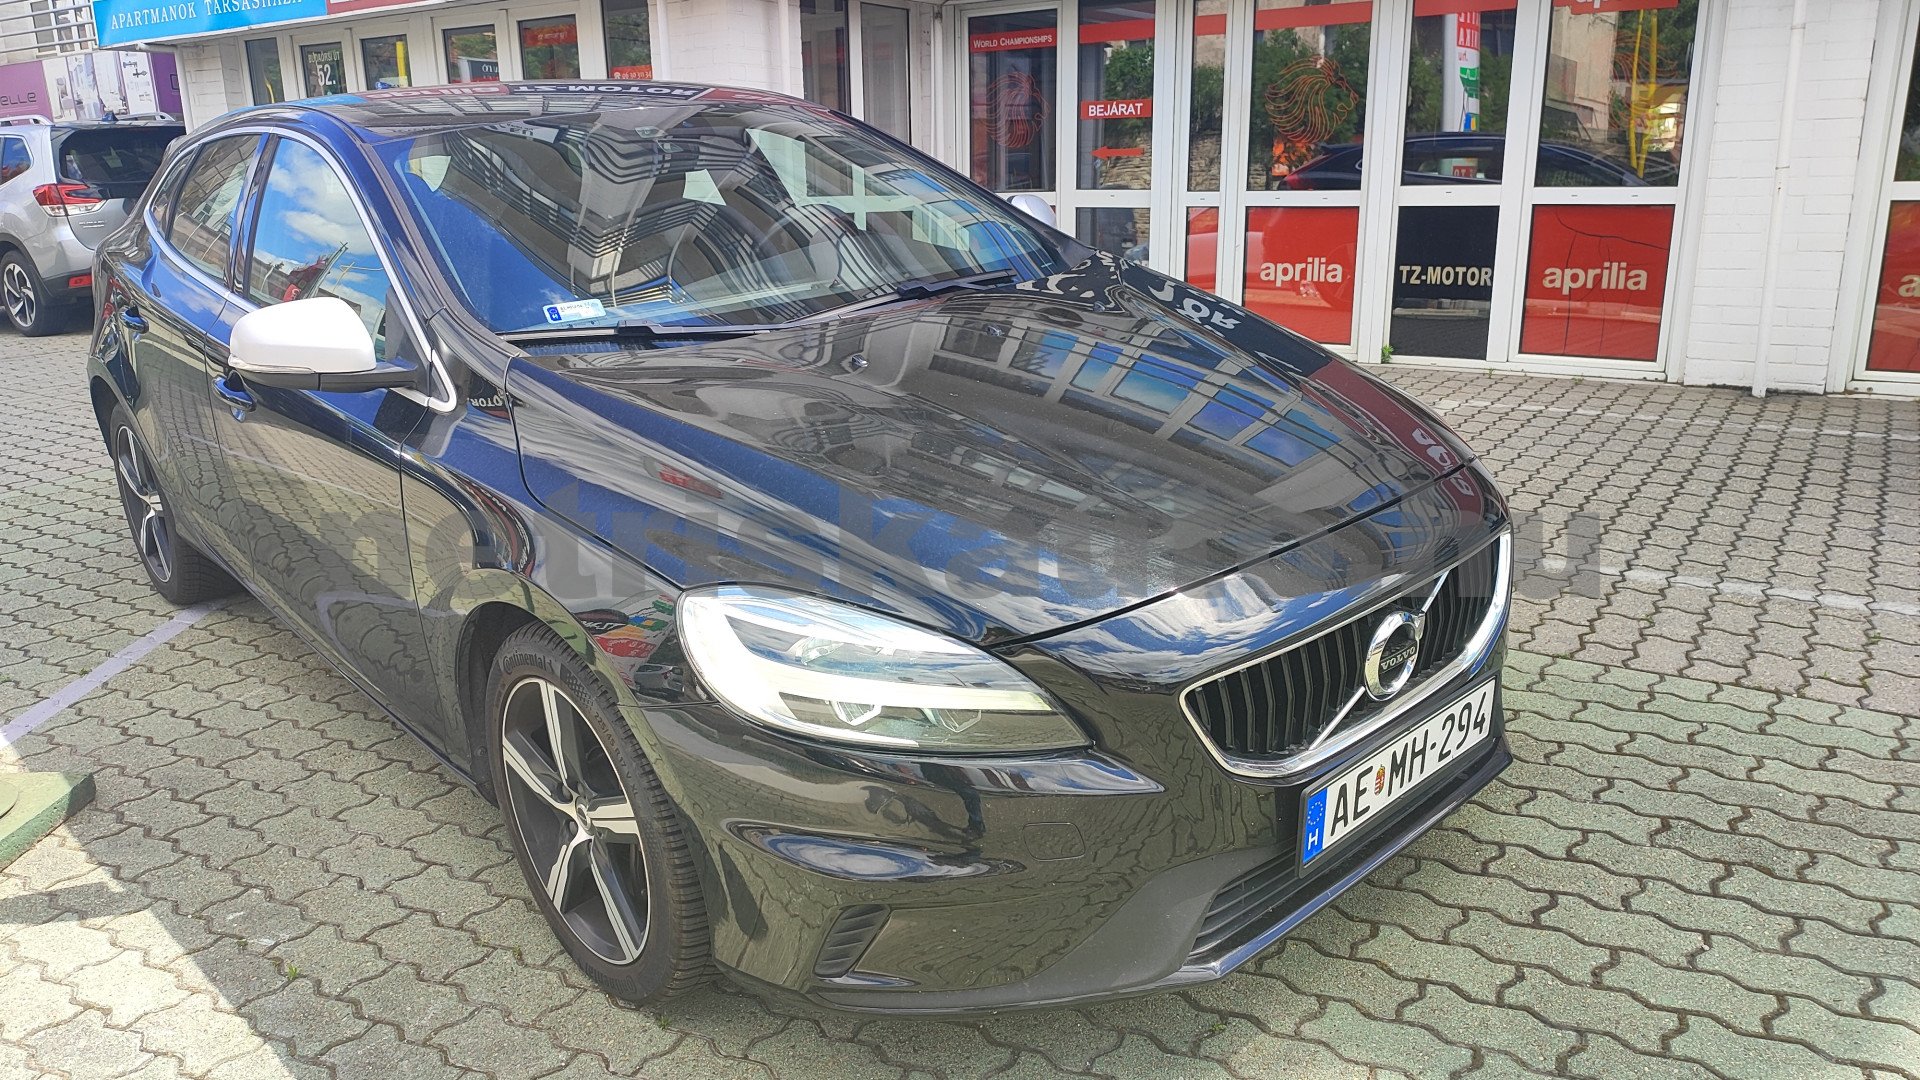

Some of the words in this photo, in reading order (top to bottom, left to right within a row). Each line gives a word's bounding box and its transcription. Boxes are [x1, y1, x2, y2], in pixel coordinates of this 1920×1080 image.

[111, 1, 197, 30] APARTMANOK
[1000, 34, 1053, 47] CHAMPIONSHIPS
[316, 64, 336, 87] 52.
[1088, 101, 1144, 117] BEJÁRAT
[1259, 257, 1343, 288] aprilia
[1399, 265, 1493, 287] TZ-MOTOR
[1542, 261, 1649, 294] aprilia
[503, 650, 547, 676] Continental
[1380, 645, 1417, 670] VOLVO
[1330, 765, 1374, 837] AE
[1387, 691, 1487, 798] MH-294
[1307, 828, 1320, 850] H
